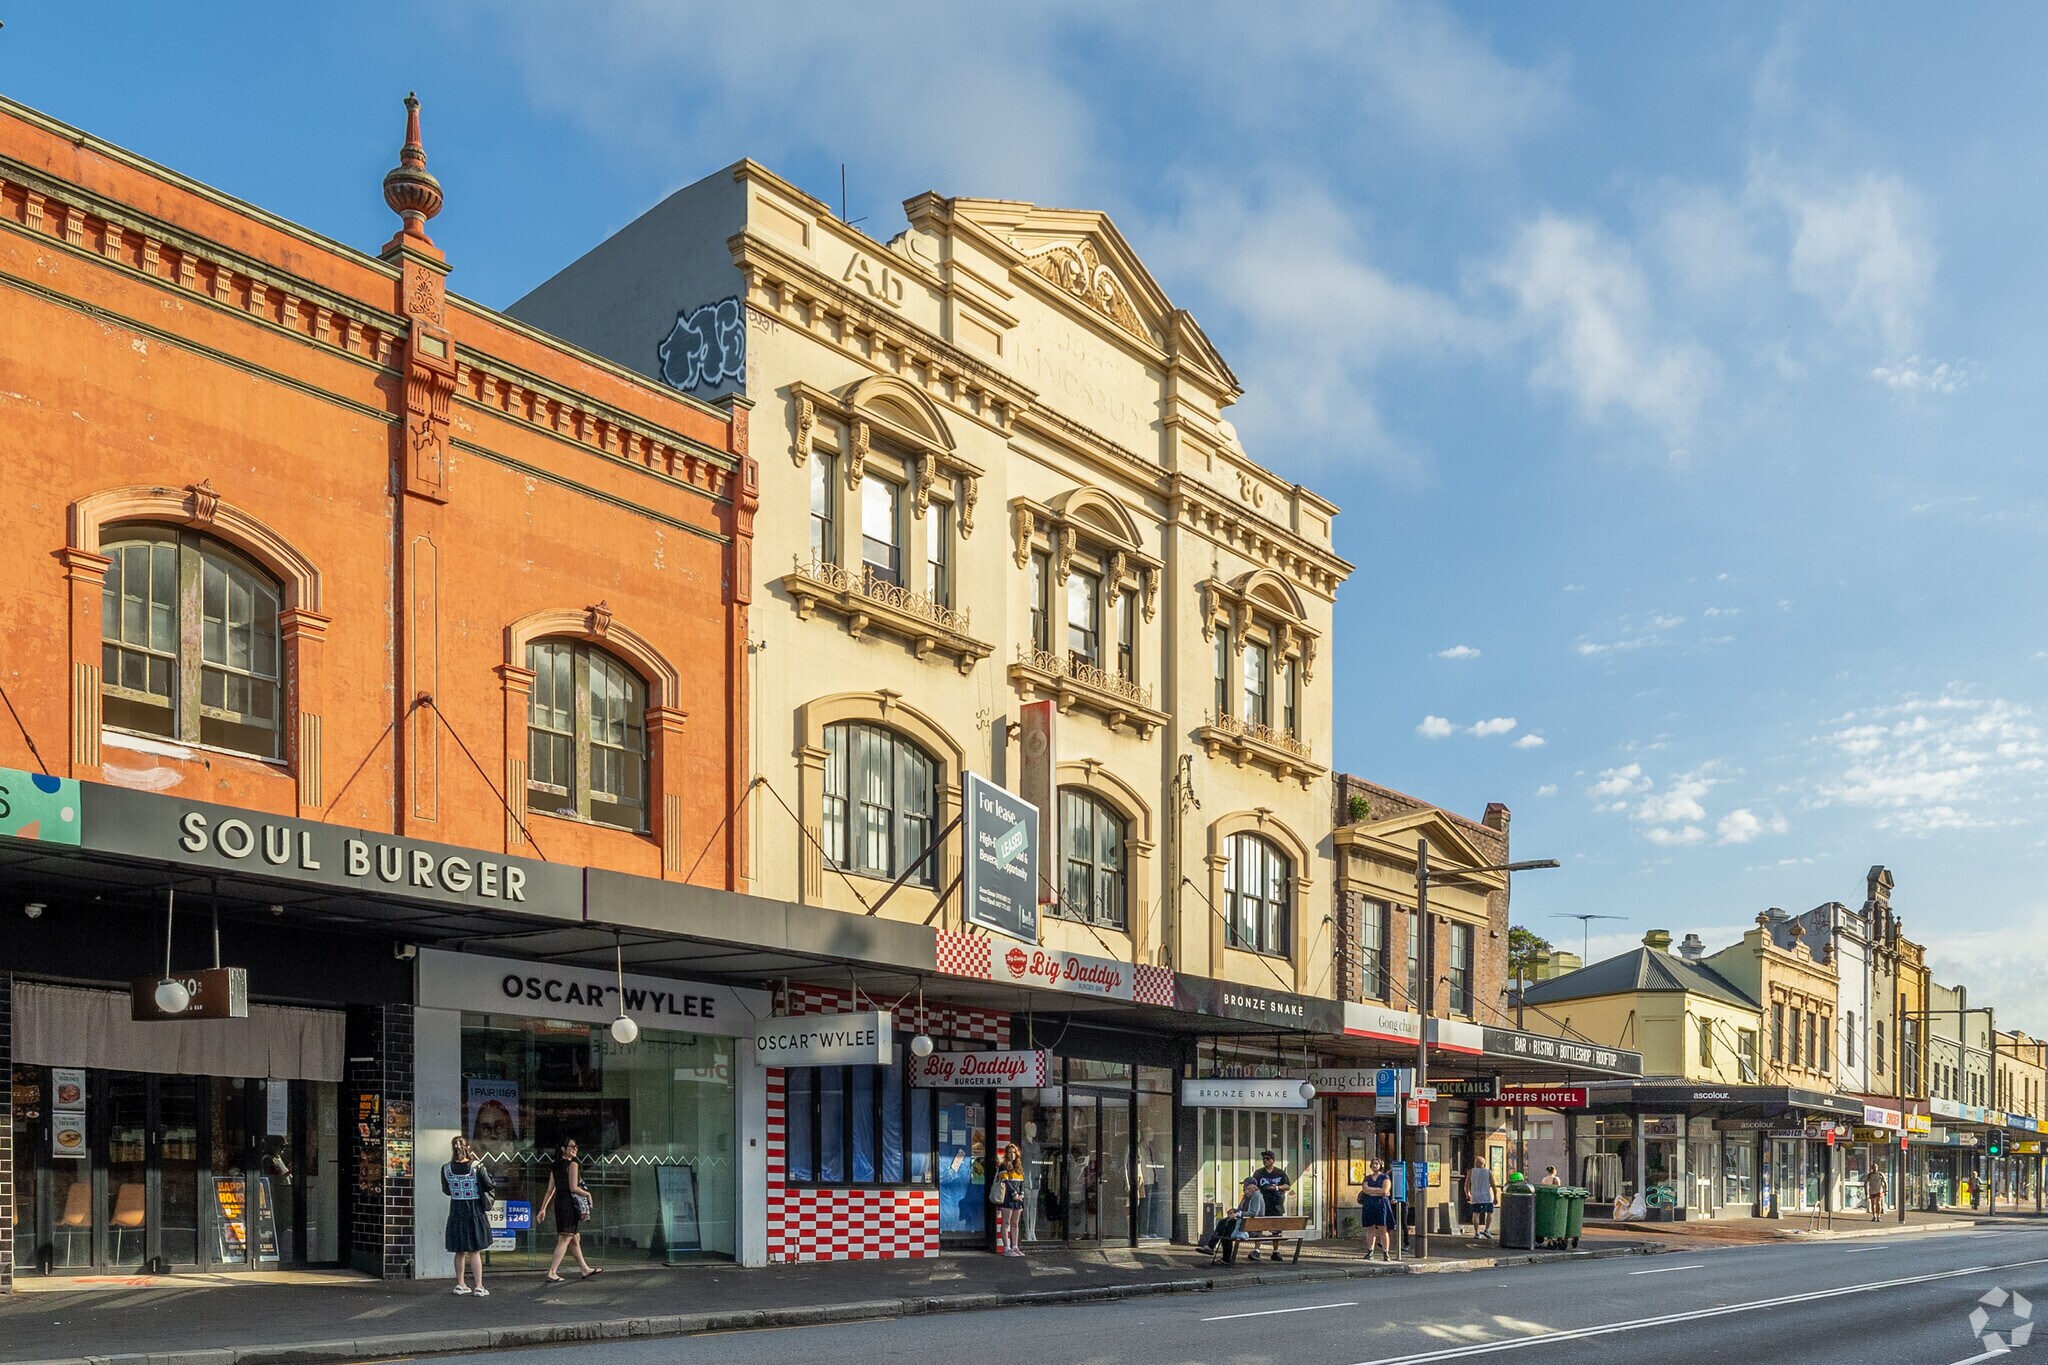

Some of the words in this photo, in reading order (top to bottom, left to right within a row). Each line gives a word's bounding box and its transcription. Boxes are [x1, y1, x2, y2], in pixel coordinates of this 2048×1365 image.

[980, 791, 994, 813] For
[1001, 831, 1023, 858] LEASED
[180, 812, 321, 870] SOUL
[346, 838, 526, 902] BURGER
[1029, 951, 1061, 984] Big
[1063, 957, 1122, 992] Daddy's
[502, 974, 604, 1008] OSCAR
[622, 988, 715, 1019] WYLEE
[1224, 994, 1265, 1010] BRONZE
[1270, 1002, 1304, 1016] SNAKE
[1378, 1015, 1398, 1035] Gong
[1399, 1019, 1412, 1033] cha
[757, 1034, 809, 1051] OSCAR
[820, 1030, 875, 1047] WYLEE
[1514, 1036, 1527, 1053] BAR
[1533, 1040, 1554, 1057] BISTRO
[1560, 1045, 1592, 1063] BOTTLESHOP
[1596, 1051, 1617, 1067] ROOFTOP
[924, 1055, 956, 1081] Big
[959, 1054, 1028, 1081] Daddy's
[954, 1077, 985, 1085] BURGER
[987, 1077, 1002, 1085] BAR
[1307, 1072, 1346, 1091] Gong
[1349, 1072, 1375, 1087] cha
[1436, 1082, 1491, 1094] COCKTAILS
[1200, 1089, 1244, 1098] BRONZE
[1250, 1090, 1288, 1098] SNAKE
[1485, 1093, 1538, 1102] OPERS
[1542, 1093, 1578, 1102] HOTEL
